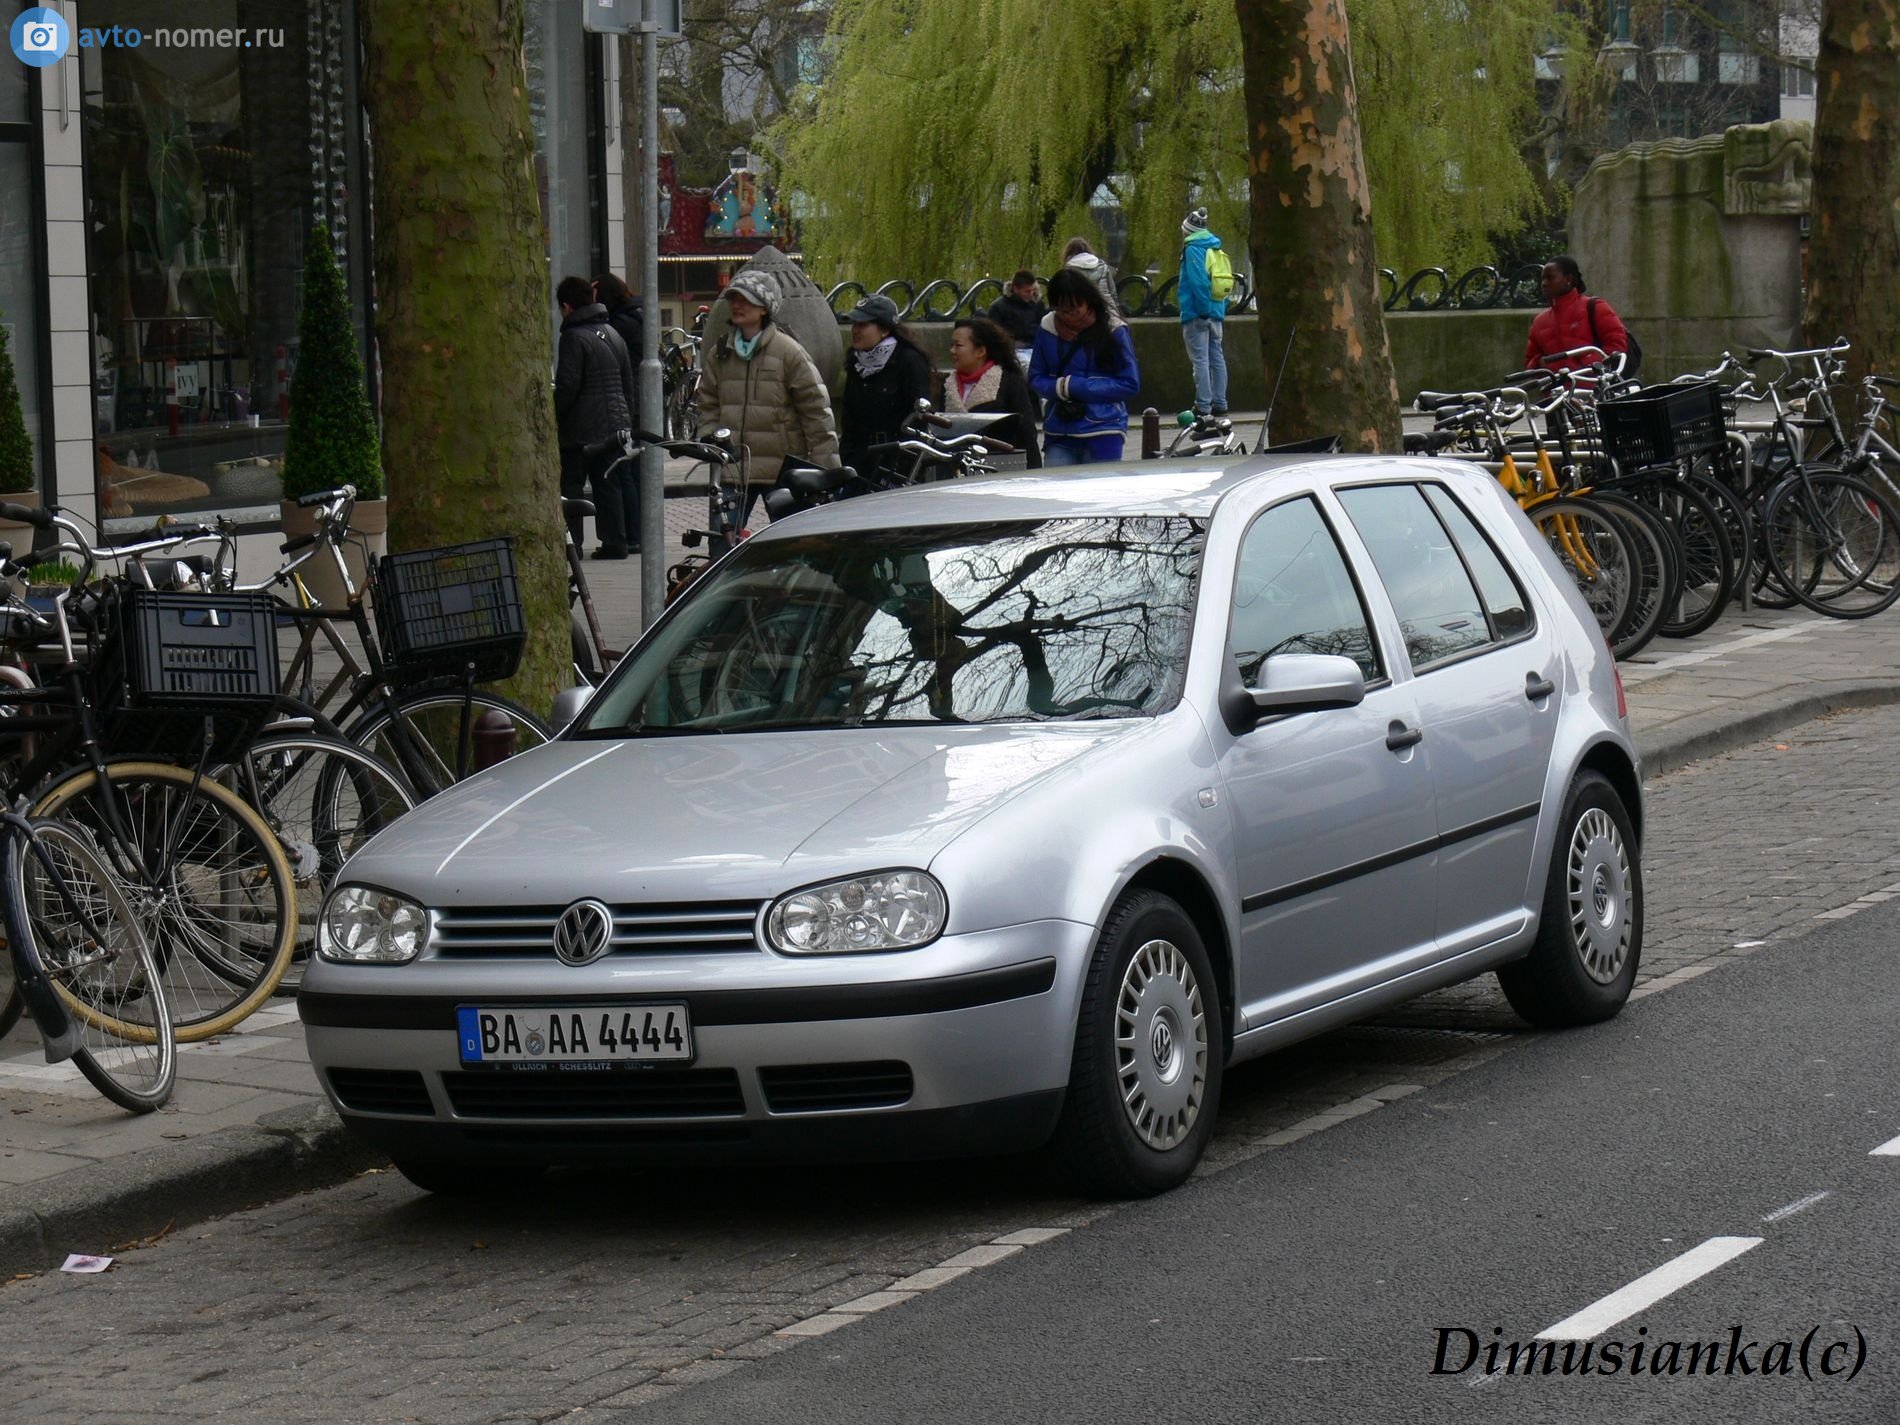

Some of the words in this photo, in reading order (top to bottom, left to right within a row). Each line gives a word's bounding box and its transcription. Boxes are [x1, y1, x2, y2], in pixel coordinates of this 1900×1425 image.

[480, 1014, 522, 1054] BA
[550, 1014, 589, 1054] AA
[600, 1012, 683, 1053] 4444
[467, 1039, 476, 1051] D
[512, 1062, 547, 1071] ULLRICH
[559, 1062, 612, 1071] SCHESSLITZ
